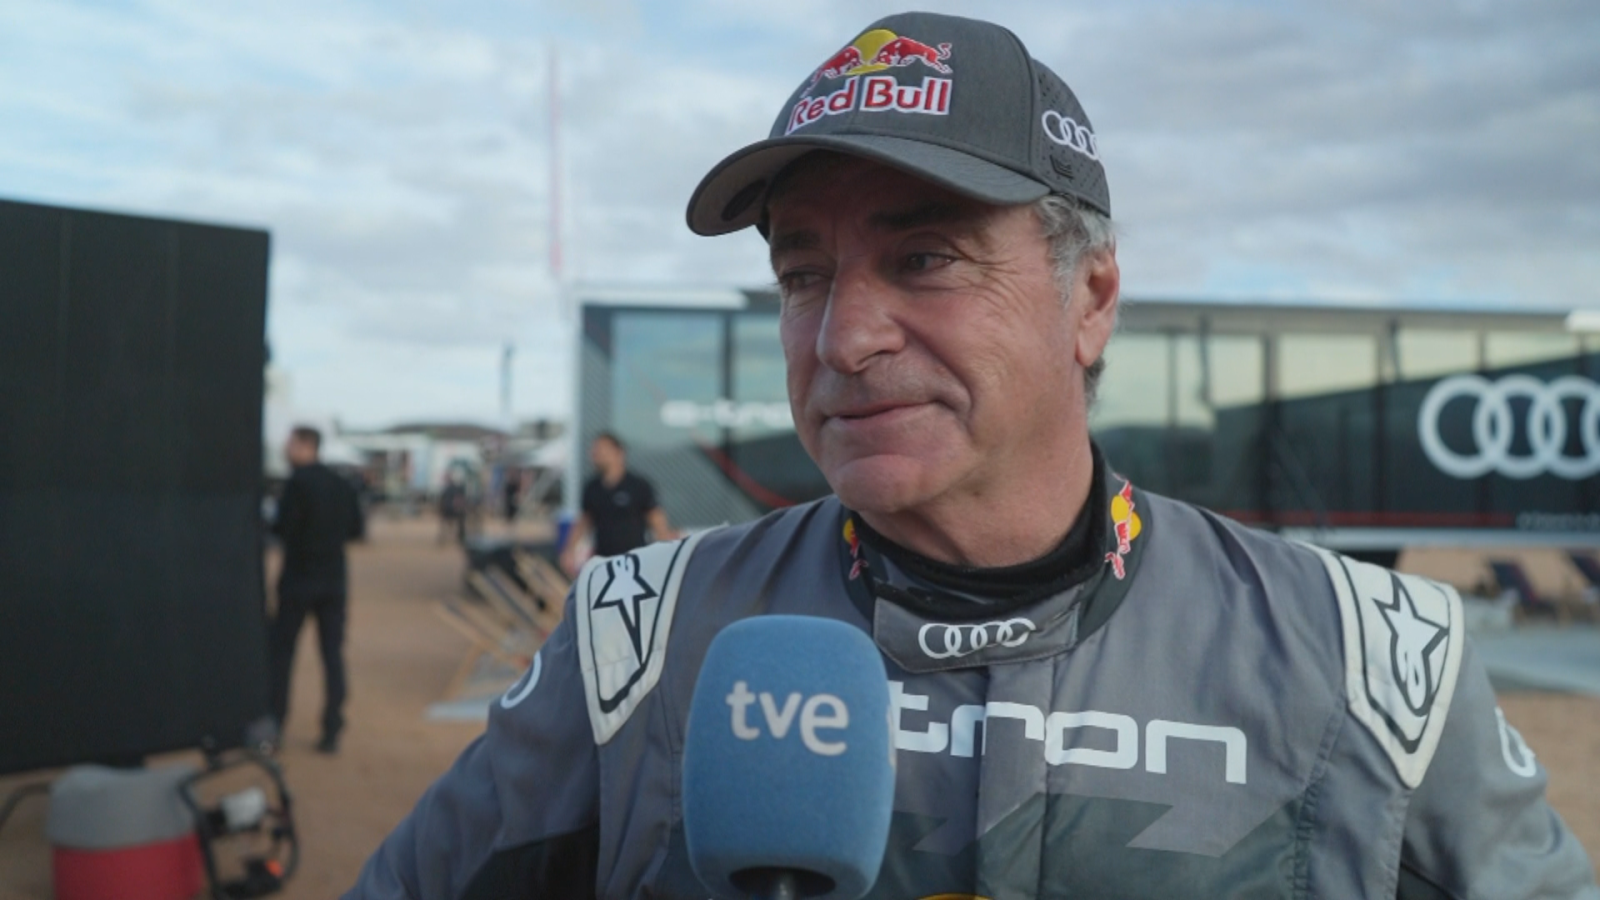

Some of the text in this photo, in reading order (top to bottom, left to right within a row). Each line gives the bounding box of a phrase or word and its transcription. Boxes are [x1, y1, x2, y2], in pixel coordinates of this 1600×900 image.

[786, 76, 951, 133] Red Bull
[725, 680, 849, 756] tve
